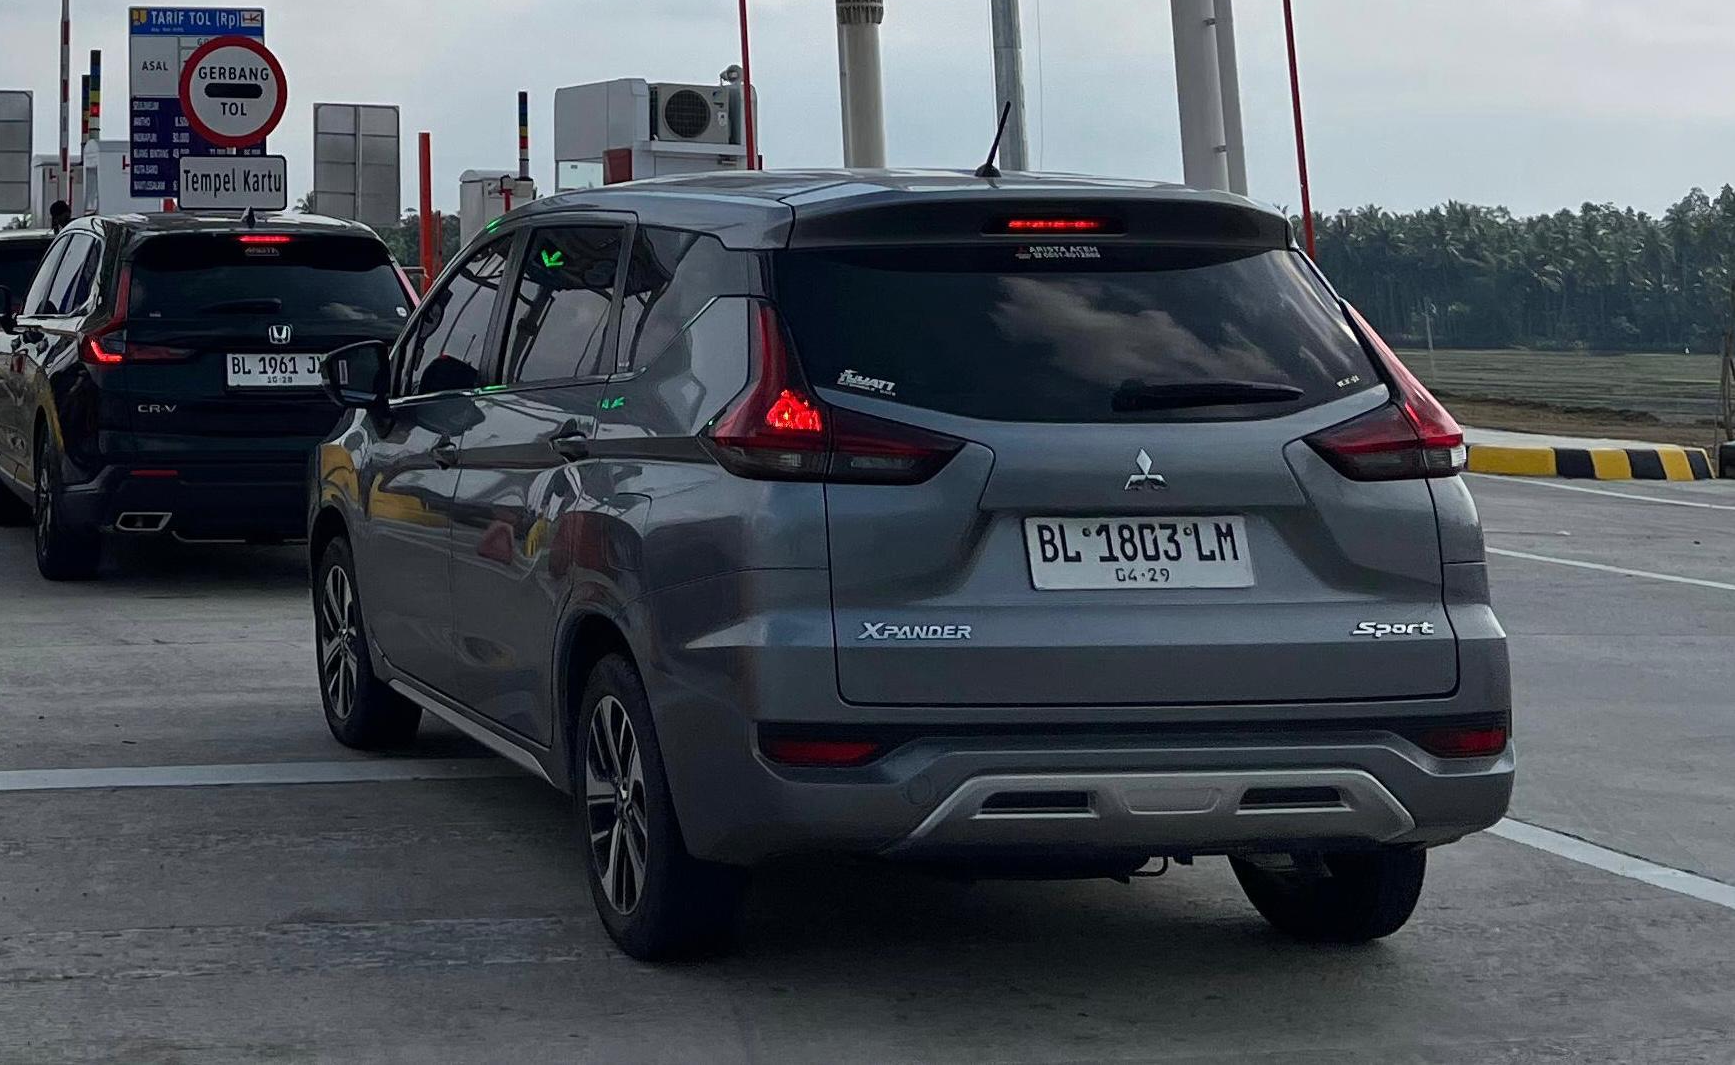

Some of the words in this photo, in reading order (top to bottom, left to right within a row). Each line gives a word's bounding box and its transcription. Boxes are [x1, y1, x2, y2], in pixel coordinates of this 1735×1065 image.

[150, 10, 185, 25] TARIF
[188, 11, 211, 26] TOL
[216, 11, 241, 29] (Rp)
[142, 60, 169, 72] ASAL
[198, 66, 270, 81] GERBANG
[220, 102, 247, 117] TOL
[183, 168, 236, 199] Tempel
[243, 169, 282, 193] Kartu
[232, 357, 252, 375] BL
[258, 357, 298, 375] 1961
[137, 404, 177, 413] CR-V
[1036, 523, 1082, 563] BL
[1096, 523, 1183, 563] 1803
[1192, 522, 1240, 562] LM
[857, 622, 972, 639] XPANDER
[1352, 621, 1435, 638] Sport
